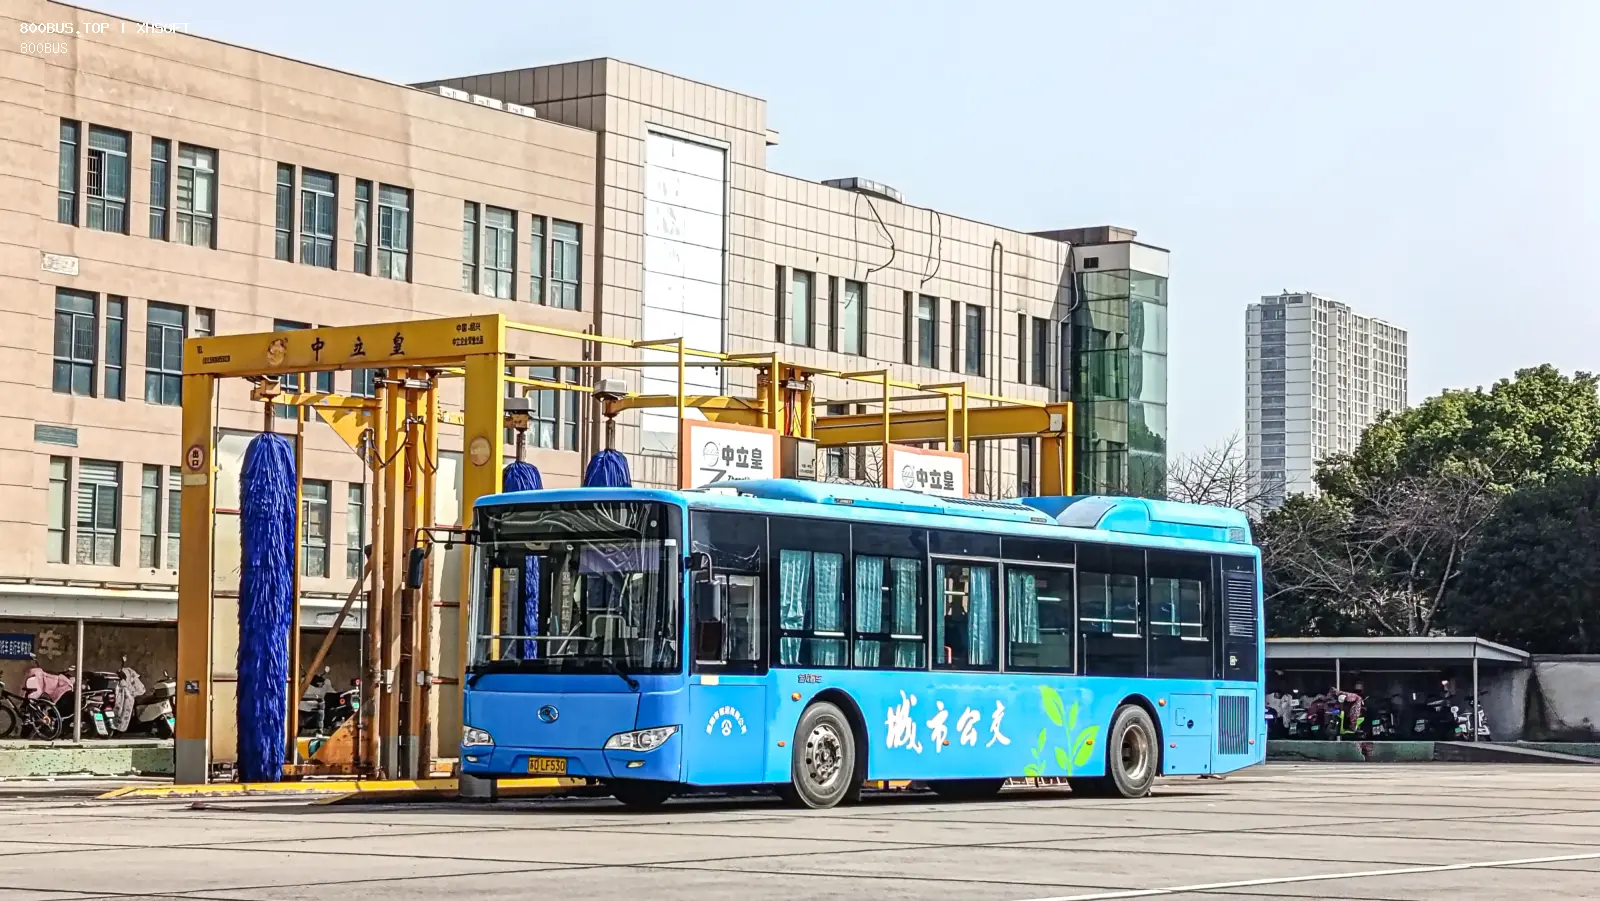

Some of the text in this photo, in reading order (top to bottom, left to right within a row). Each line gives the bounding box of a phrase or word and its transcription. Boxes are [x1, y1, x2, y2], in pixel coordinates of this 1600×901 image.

[311, 332, 405, 361] 中立皇
[721, 445, 763, 470] 中立皇
[916, 468, 955, 491] 中立皇
[885, 690, 1011, 754] 城市公交
